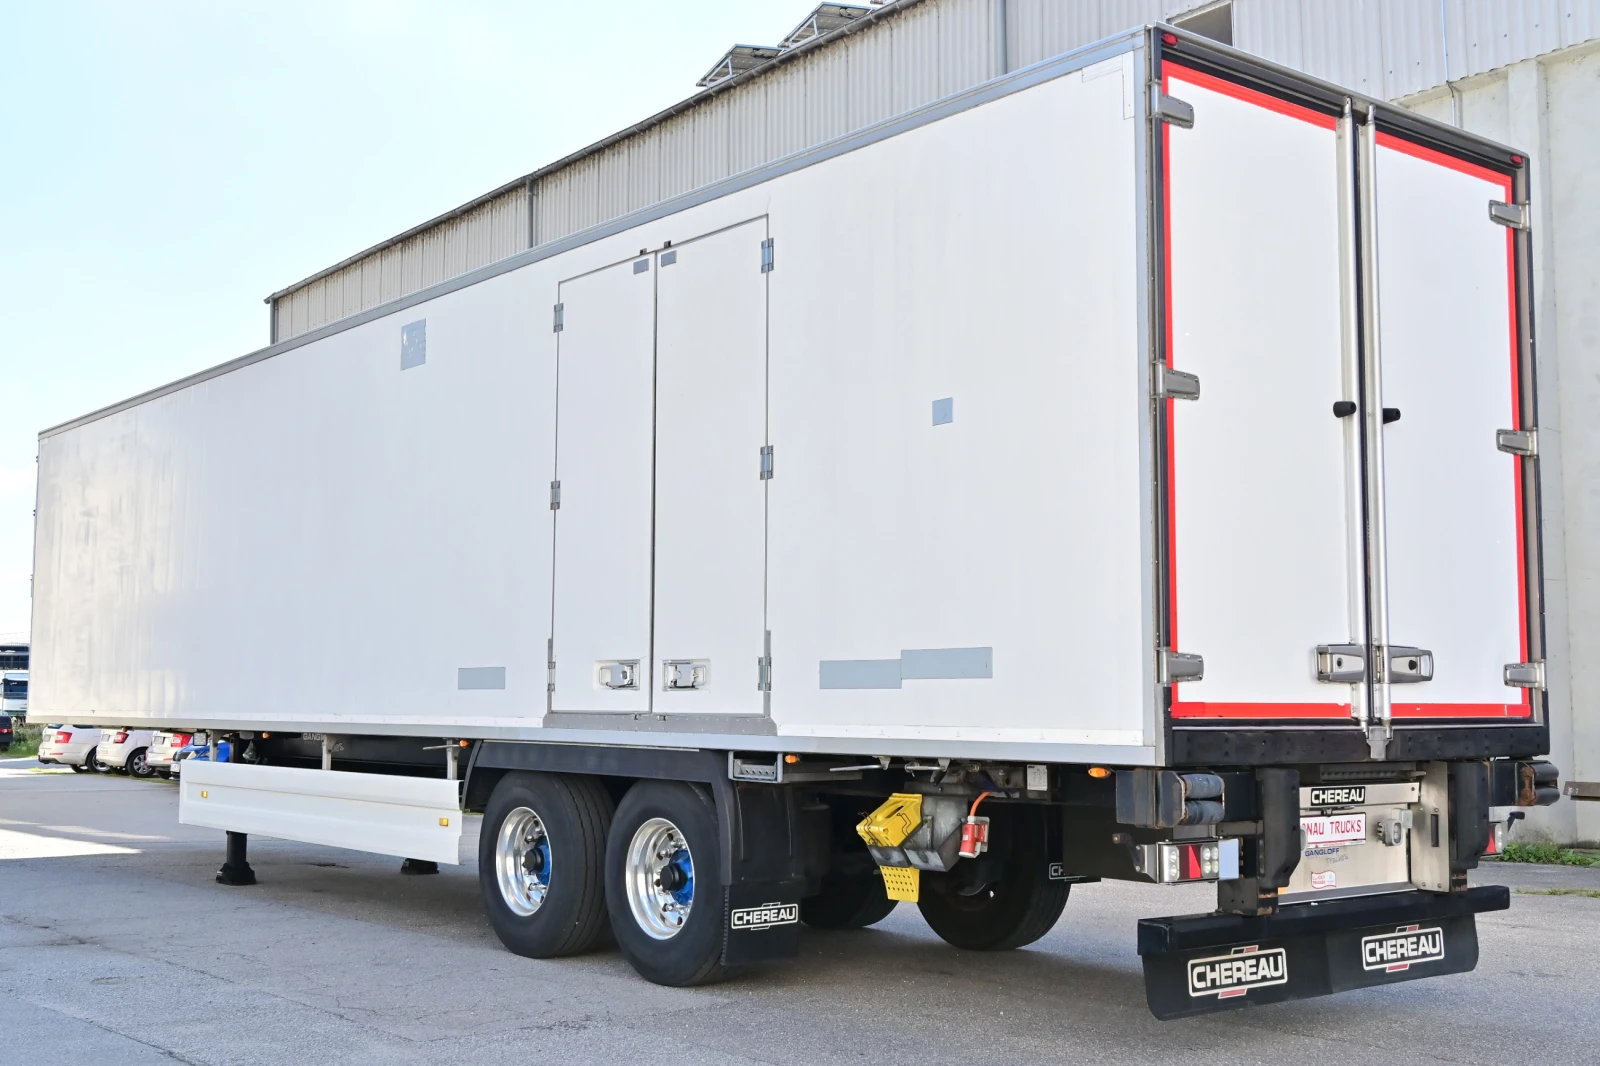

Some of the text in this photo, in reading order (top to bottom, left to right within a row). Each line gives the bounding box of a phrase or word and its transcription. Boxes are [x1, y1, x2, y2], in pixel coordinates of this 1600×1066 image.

[1311, 788, 1364, 804] CHEREAU
[1330, 820, 1361, 834] TRUCKS
[1305, 847, 1340, 857] GANGLOFF
[734, 907, 796, 925] CHEREAU
[1365, 933, 1441, 963] CHEREAU
[1192, 955, 1283, 989] CHEREAU
